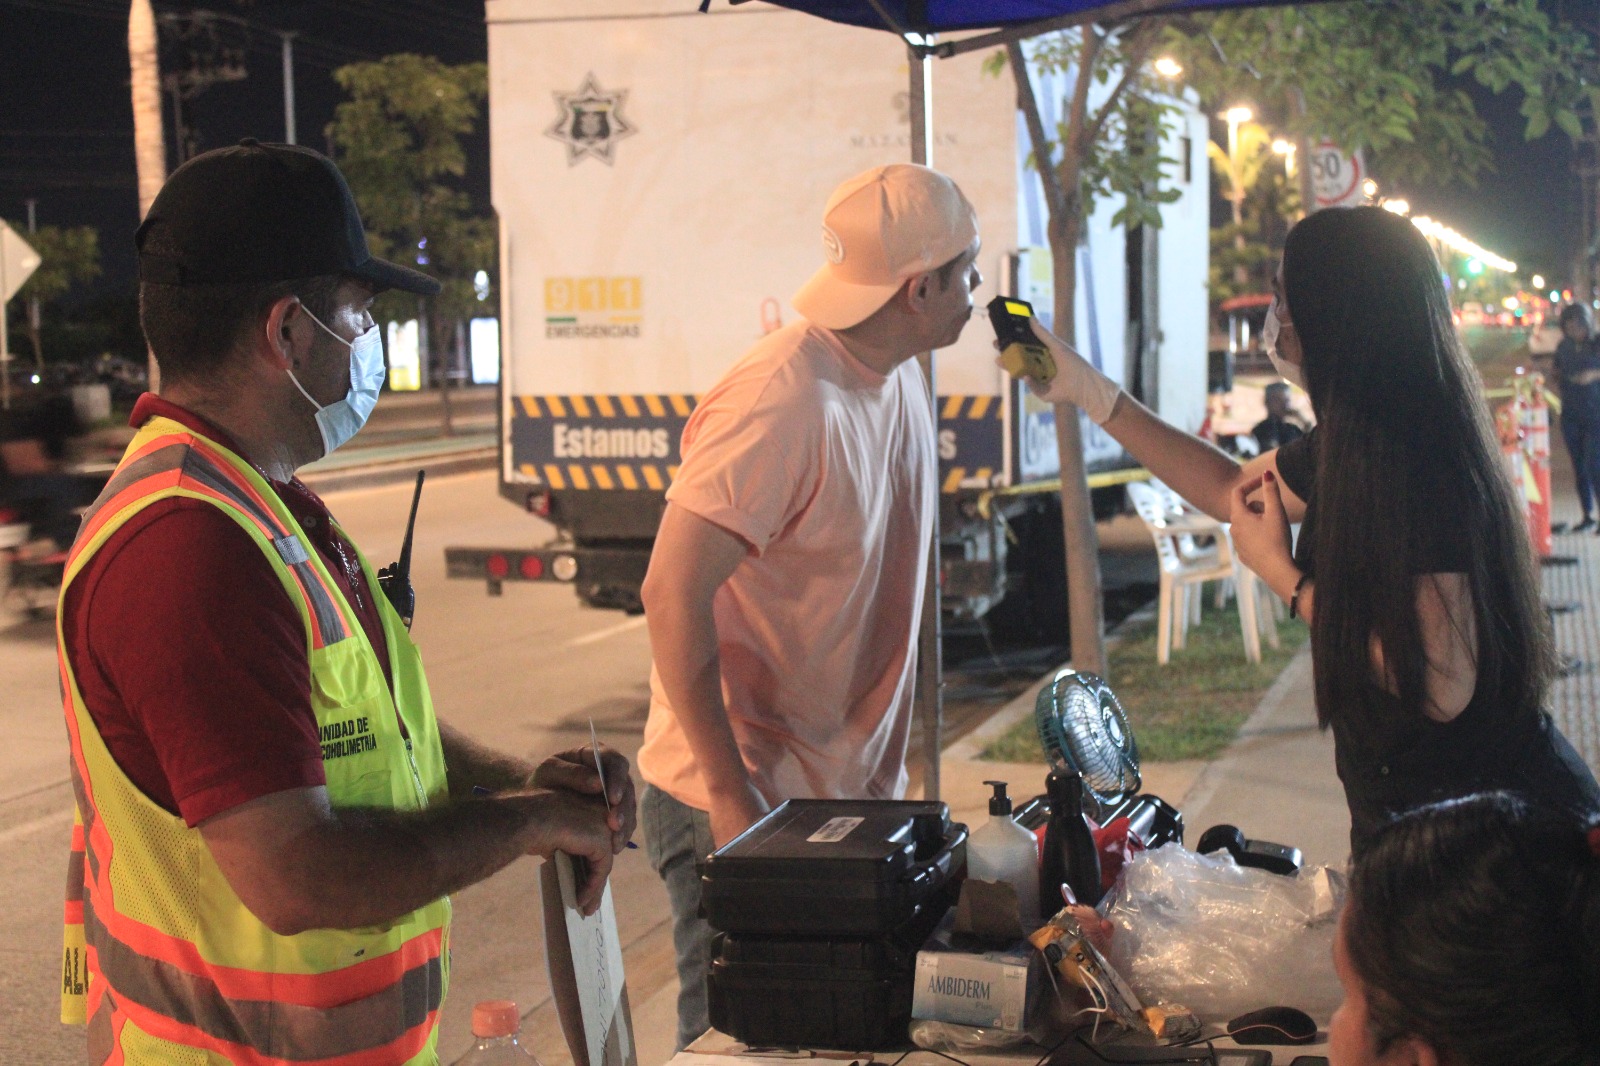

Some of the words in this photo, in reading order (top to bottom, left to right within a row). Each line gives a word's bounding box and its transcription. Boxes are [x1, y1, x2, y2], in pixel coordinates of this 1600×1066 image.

[850, 133, 958, 148] MAZAAN
[1310, 152, 1340, 179] 50
[546, 279, 638, 310] 911
[545, 325, 640, 339] EMERGENCIAS
[553, 423, 669, 458] Estamos
[356, 717, 369, 734] DE
[928, 975, 990, 1000] AMBIDERM
